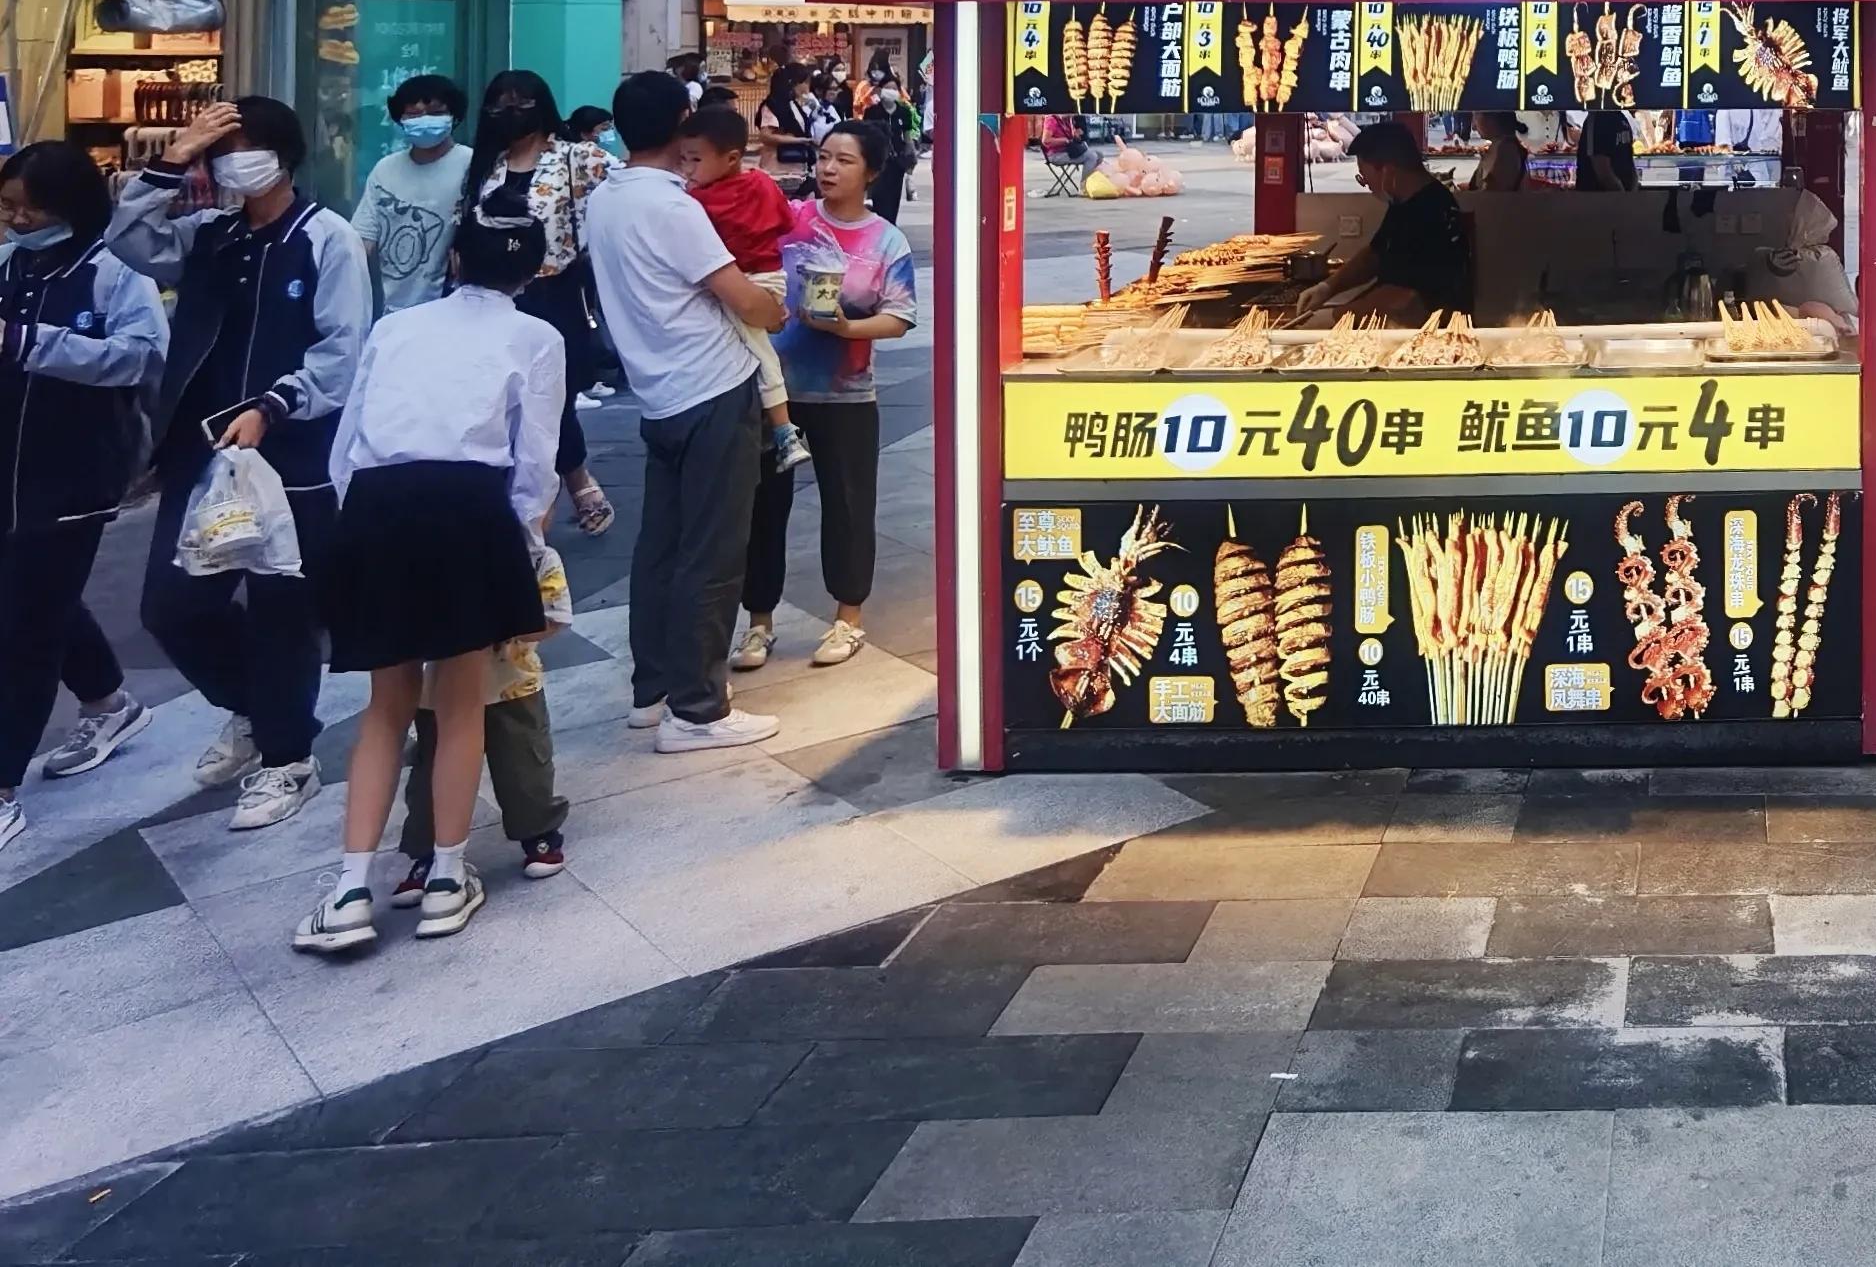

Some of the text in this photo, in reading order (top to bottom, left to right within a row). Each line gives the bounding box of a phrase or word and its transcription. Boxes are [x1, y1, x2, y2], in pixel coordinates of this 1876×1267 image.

[1160, 2, 1184, 98] 户部大面筋
[1329, 9, 1353, 92] 蒙古肉串
[1496, 7, 1520, 90] 铁板鸭肠
[1831, 7, 1850, 91] 将军大鱿鱼
[1063, 379, 1786, 472] 鸭肠10元40串 鱿鱼10元4串
[1018, 511, 1056, 532] 至尊
[1018, 534, 1074, 557] 大鱿鱼
[1359, 531, 1377, 625] 铁板小鸭肠
[1568, 579, 1592, 596] 15
[1015, 586, 1042, 608] 15
[1171, 592, 1198, 612] 10
[1566, 634, 1594, 654] 1串
[1731, 628, 1752, 646] 15
[1015, 644, 1044, 662] 1个
[1169, 646, 1199, 667] 4串
[1359, 645, 1381, 661] 10
[1153, 679, 1189, 699] 手工
[1733, 676, 1755, 694] 1串
[1357, 690, 1391, 707] 40串
[1153, 702, 1206, 722] 大面筋
